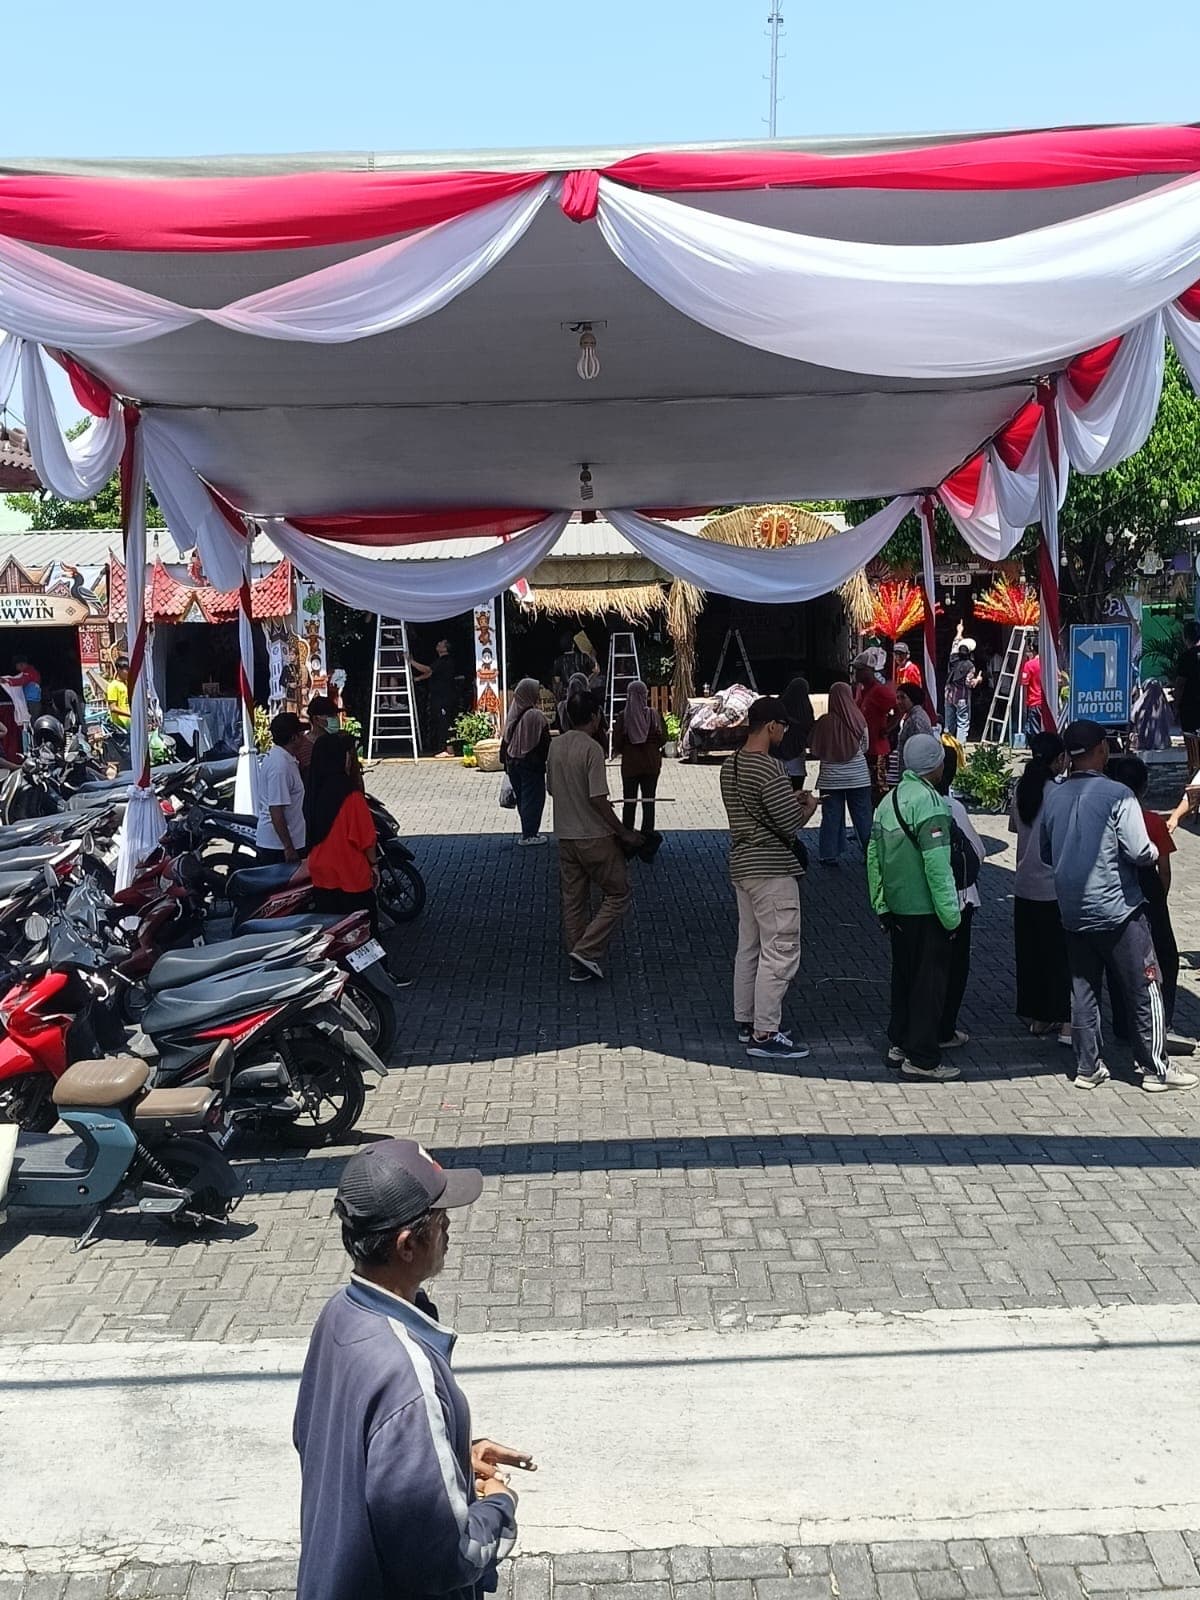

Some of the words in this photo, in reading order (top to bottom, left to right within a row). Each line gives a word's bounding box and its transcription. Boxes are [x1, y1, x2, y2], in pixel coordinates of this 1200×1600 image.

[15, 598, 32, 607] RW
[35, 598, 47, 606] IX
[0, 606, 54, 619] WWIN
[1078, 690, 1122, 701] PARKIR
[1078, 702, 1123, 714] MOTOR
